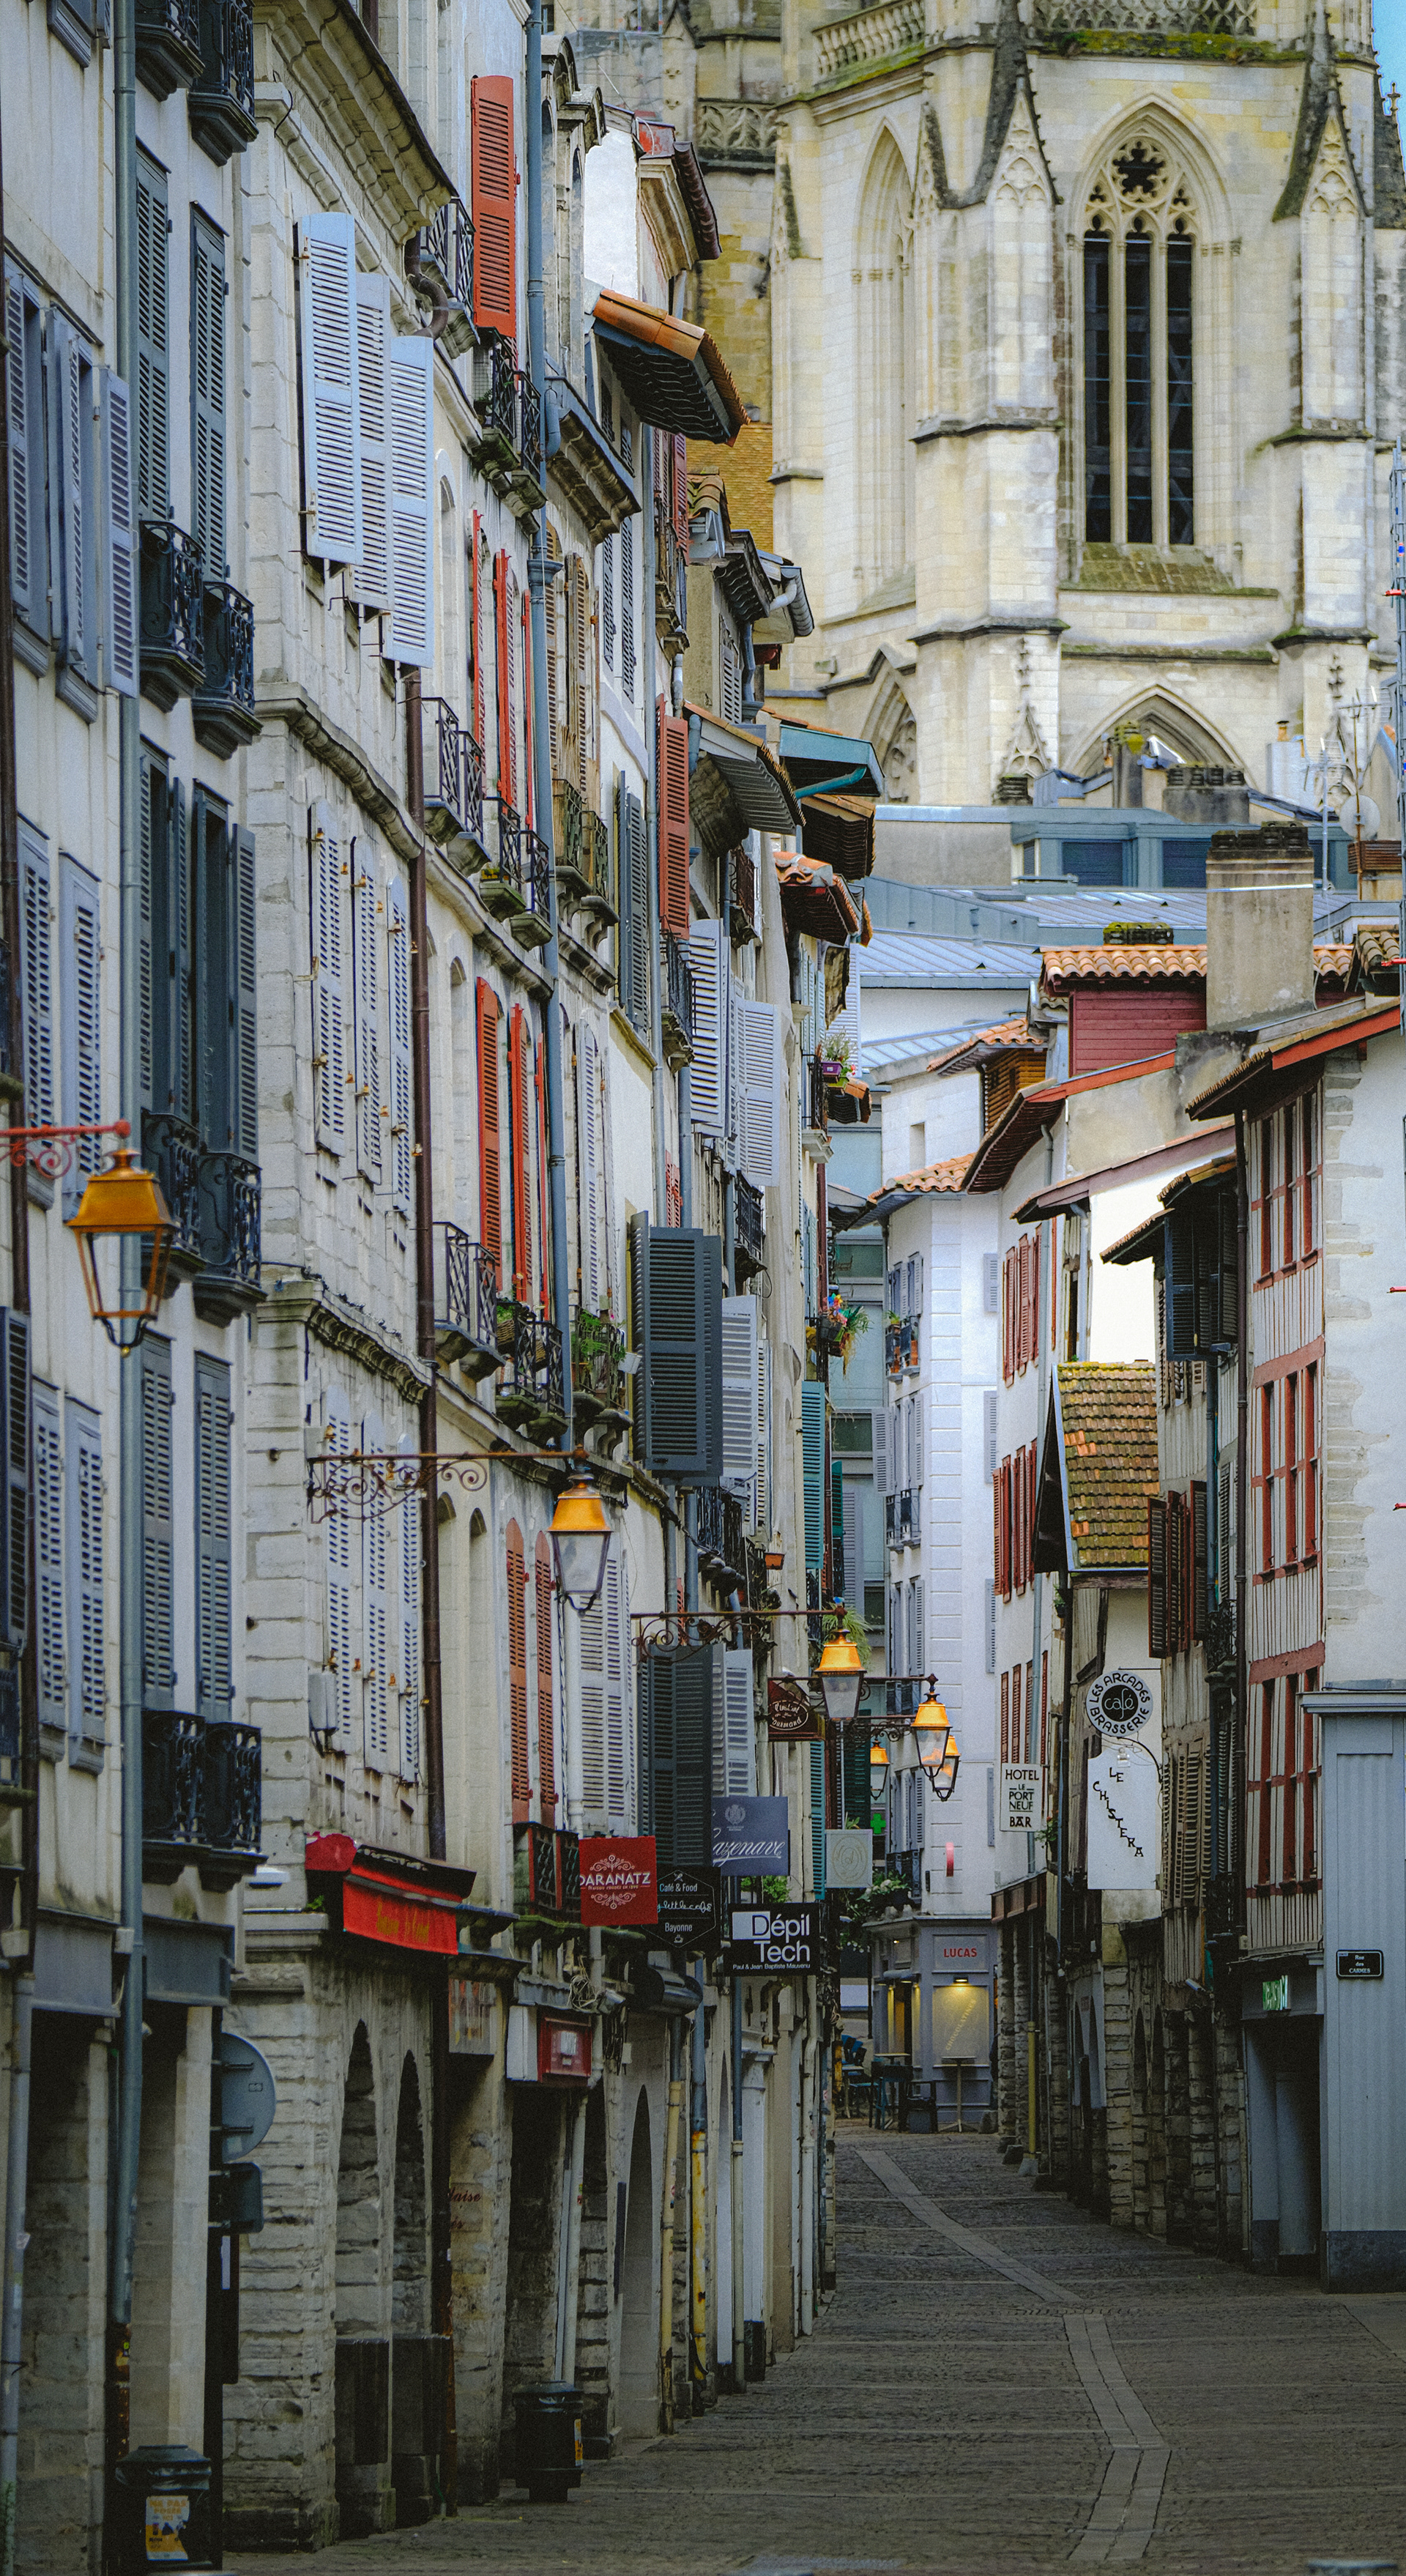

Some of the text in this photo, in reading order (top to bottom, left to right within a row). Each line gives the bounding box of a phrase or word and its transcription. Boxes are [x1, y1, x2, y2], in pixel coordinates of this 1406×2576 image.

[1090, 1672, 1150, 1703] LES ARCADES
[1104, 1688, 1135, 1720] café
[1090, 1707, 1150, 1734] BRASSERIE
[1005, 1769, 1039, 1780] HOTEL
[1109, 1767, 1124, 1782] LE
[1009, 1792, 1034, 1800] PORT
[1009, 1801, 1033, 1810] NEUF
[1009, 1816, 1032, 1827] BAR
[1093, 1781, 1144, 1857] CHISTERA
[713, 1838, 786, 1867] azenave
[660, 1883, 698, 1892] Café & Food
[665, 1922, 693, 1933] Bayonne
[752, 1913, 810, 1943] Dépil
[754, 1940, 810, 1962] Tech
[943, 1948, 978, 1957] LUCAS
